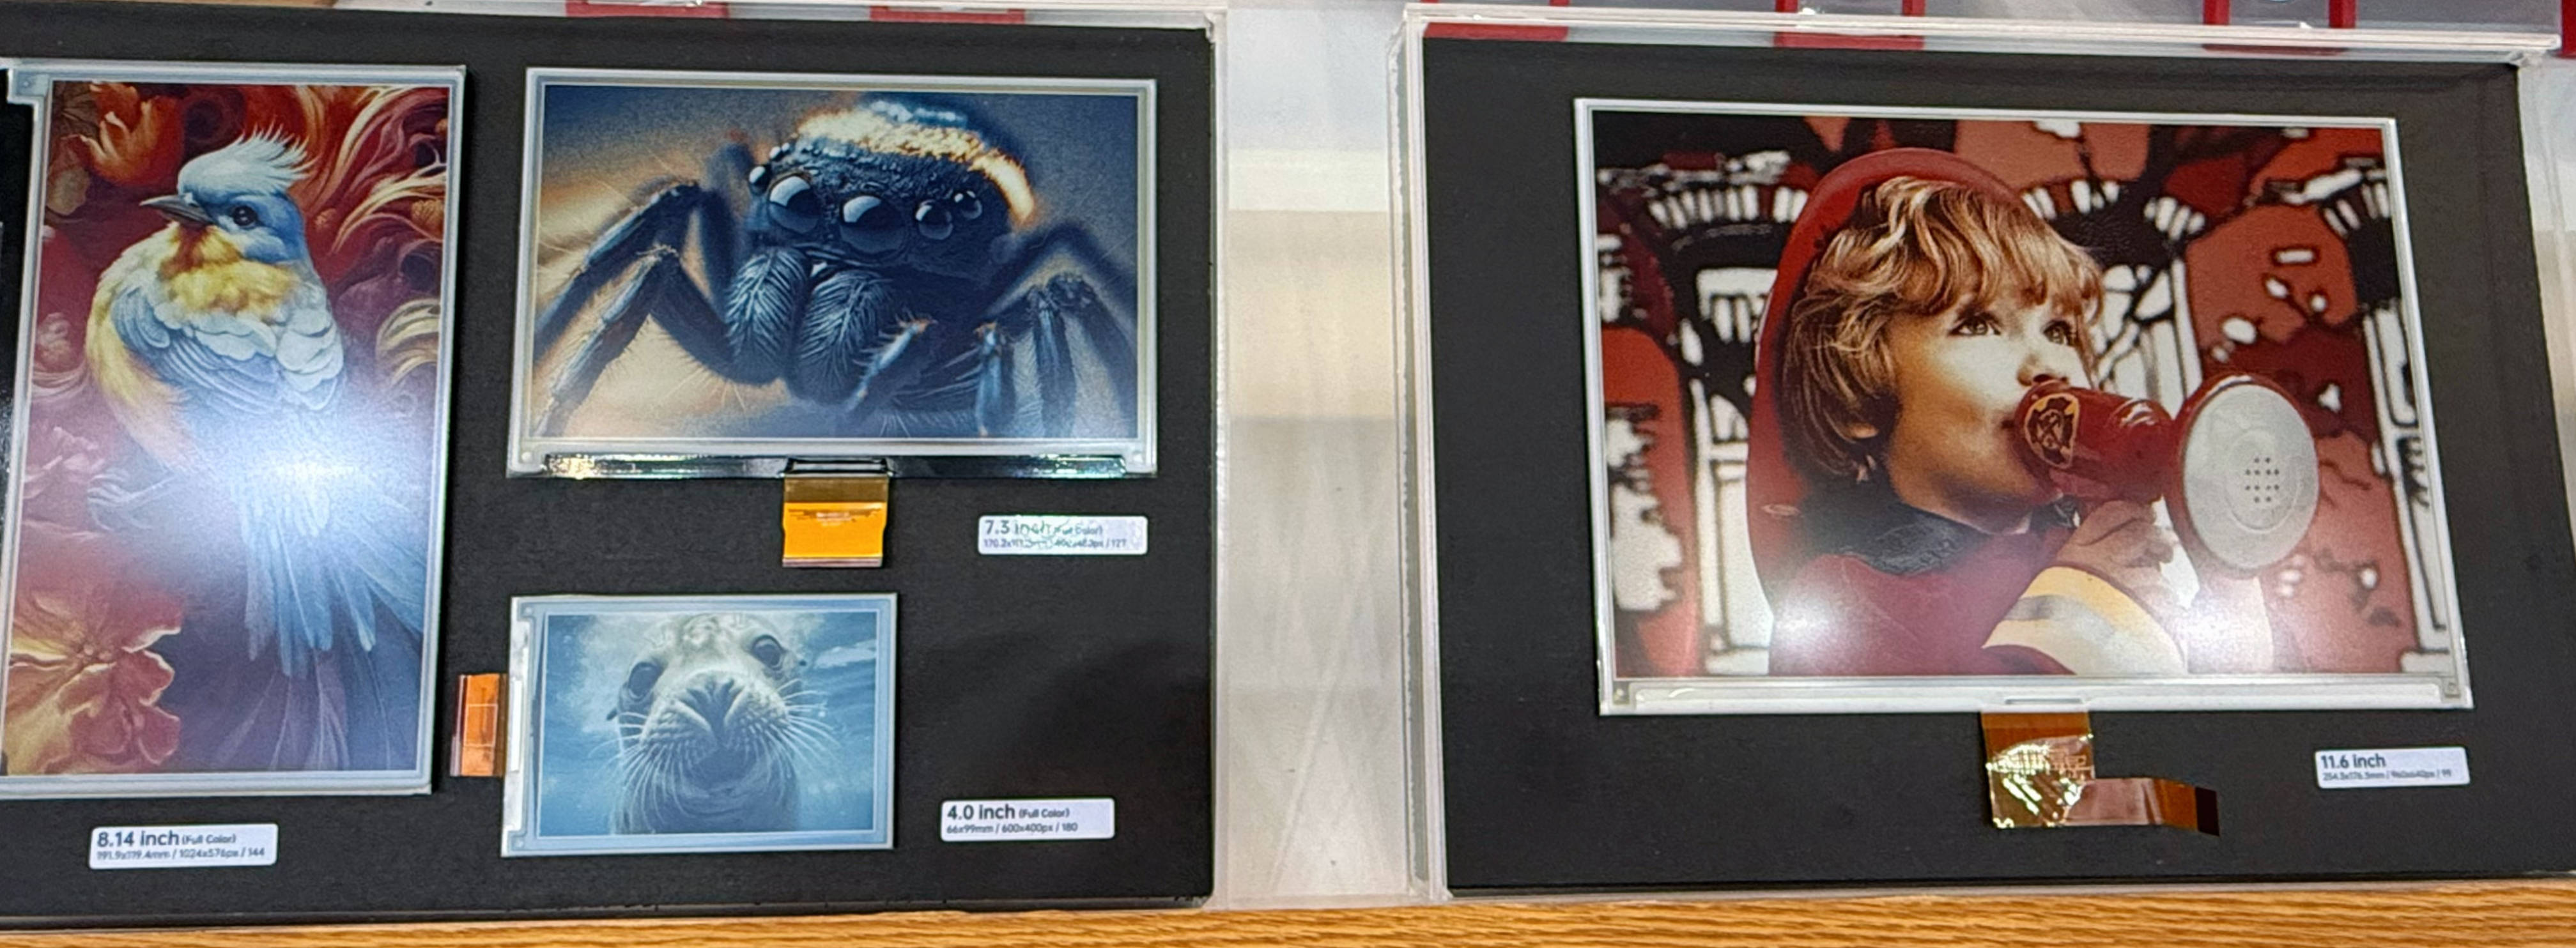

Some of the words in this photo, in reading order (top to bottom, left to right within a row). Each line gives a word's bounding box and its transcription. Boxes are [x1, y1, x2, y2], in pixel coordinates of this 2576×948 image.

[984, 519, 1010, 535] 7.3
[1014, 519, 1051, 535] inch
[2321, 755, 2349, 768] 11.6
[2353, 754, 2386, 767] inch
[947, 805, 974, 820] 4.0
[979, 804, 1015, 820] inch
[1019, 808, 1039, 818] (Full
[1041, 807, 1070, 818] Color)
[946, 824, 993, 834] 66x99mm
[995, 823, 999, 834] /
[1001, 823, 1053, 834] 600x400px
[1055, 823, 1060, 833] /
[1061, 822, 1078, 832] 180
[97, 831, 134, 847] 8.14
[141, 830, 179, 846] inch
[182, 834, 203, 845] (Full
[206, 834, 236, 844] Color)
[172, 848, 176, 859] /
[241, 848, 245, 857] /
[247, 847, 265, 857] 144
